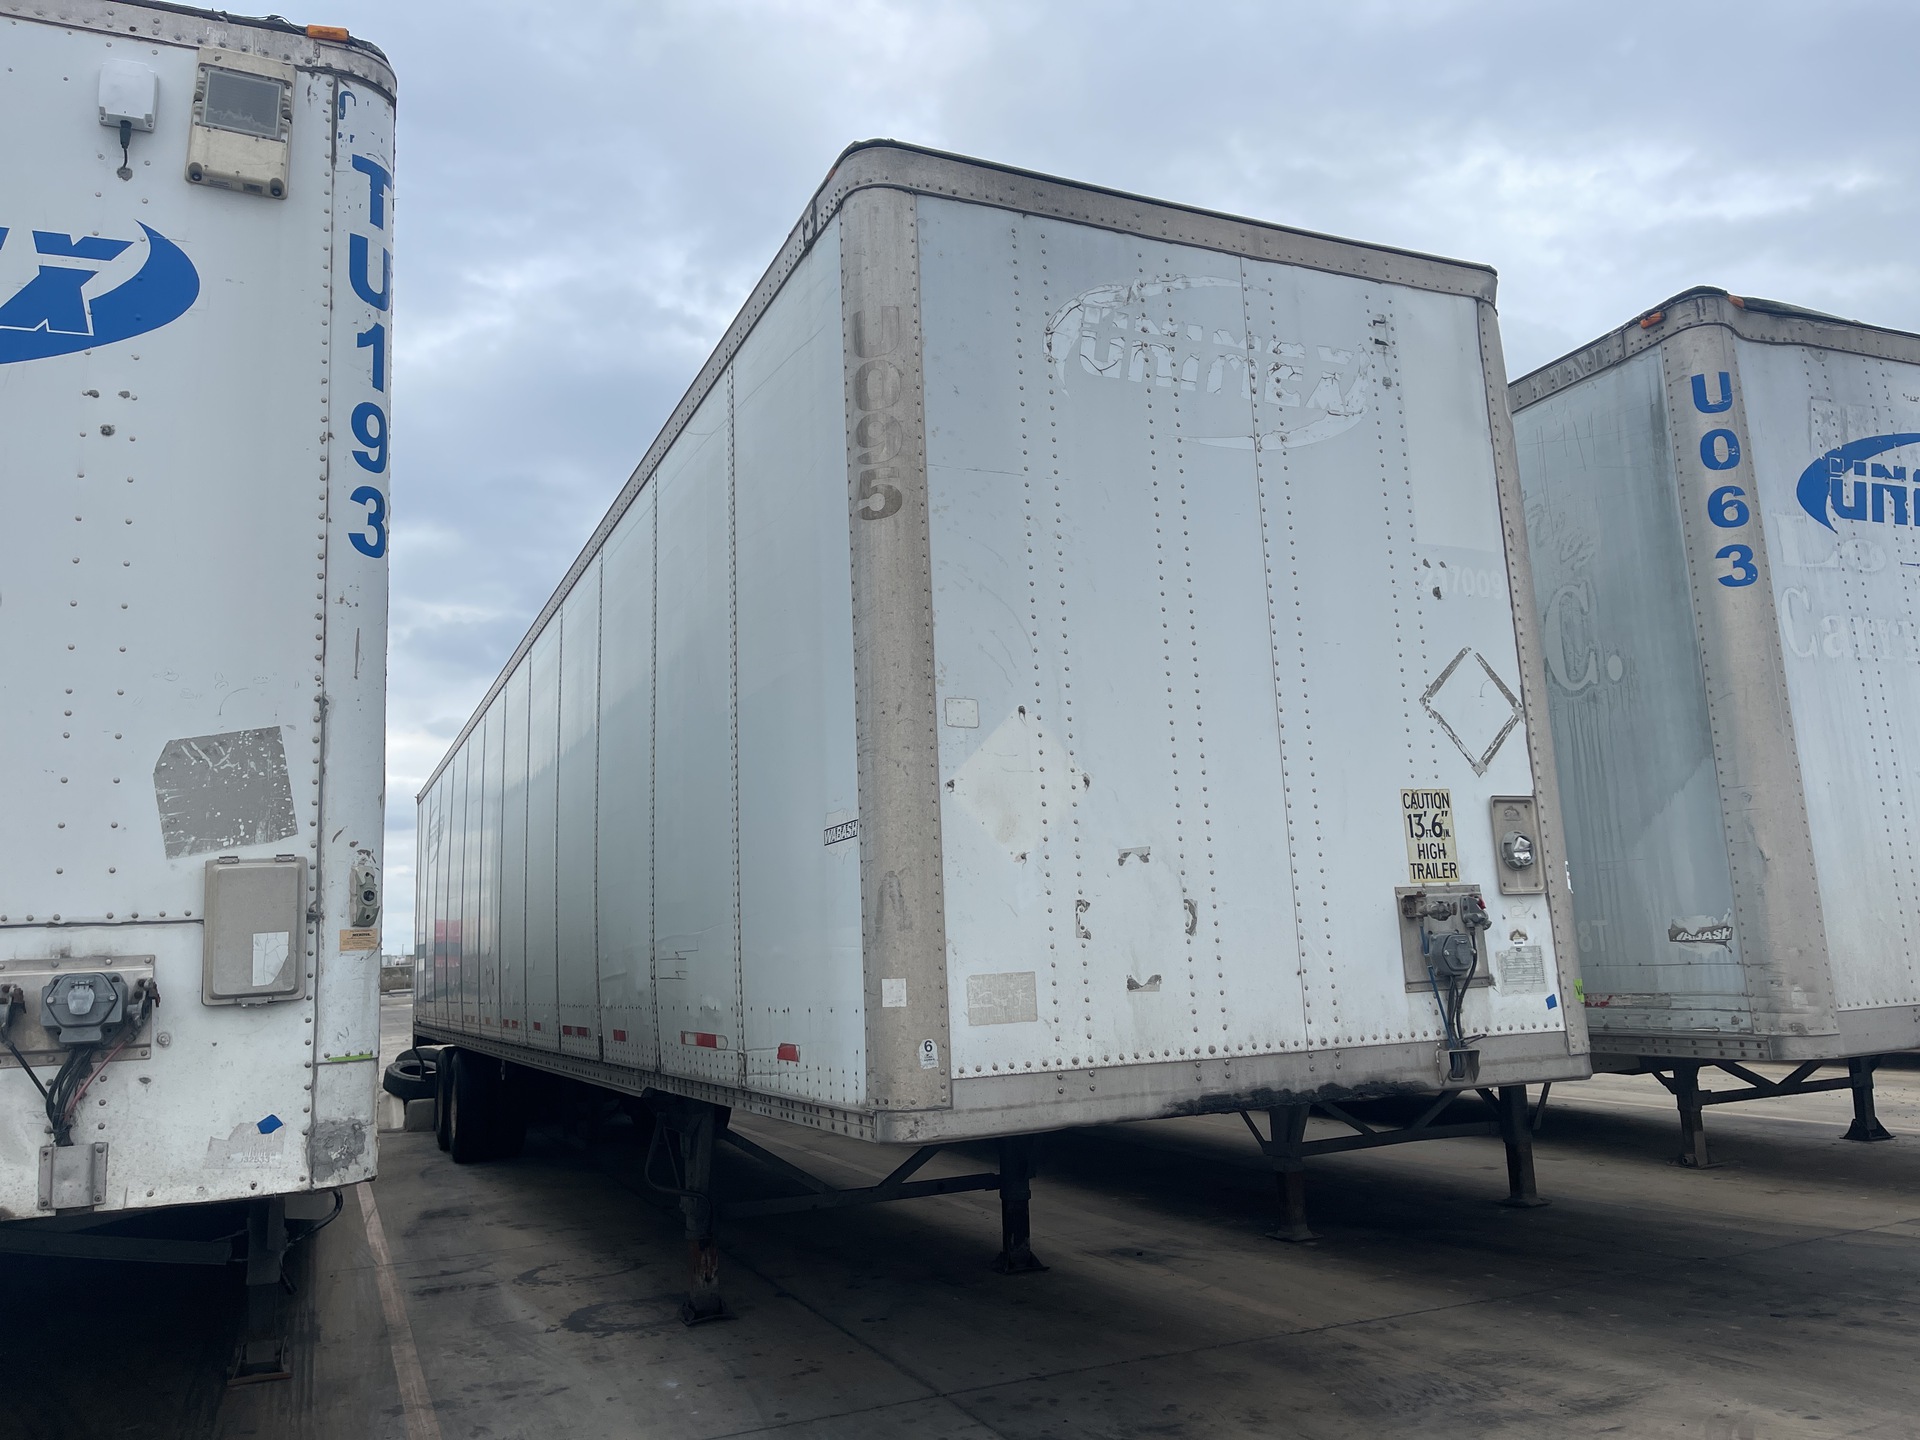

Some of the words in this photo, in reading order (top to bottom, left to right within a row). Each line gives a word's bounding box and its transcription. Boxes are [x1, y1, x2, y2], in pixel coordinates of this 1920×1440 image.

[853, 305, 903, 521] U095
[1691, 371, 1759, 588] U063
[1402, 792, 1451, 809] CAUTION
[824, 820, 858, 845] WABASH
[1417, 842, 1447, 860] HIGH
[1410, 862, 1458, 879] TRAILER
[924, 1040, 933, 1053] 6
